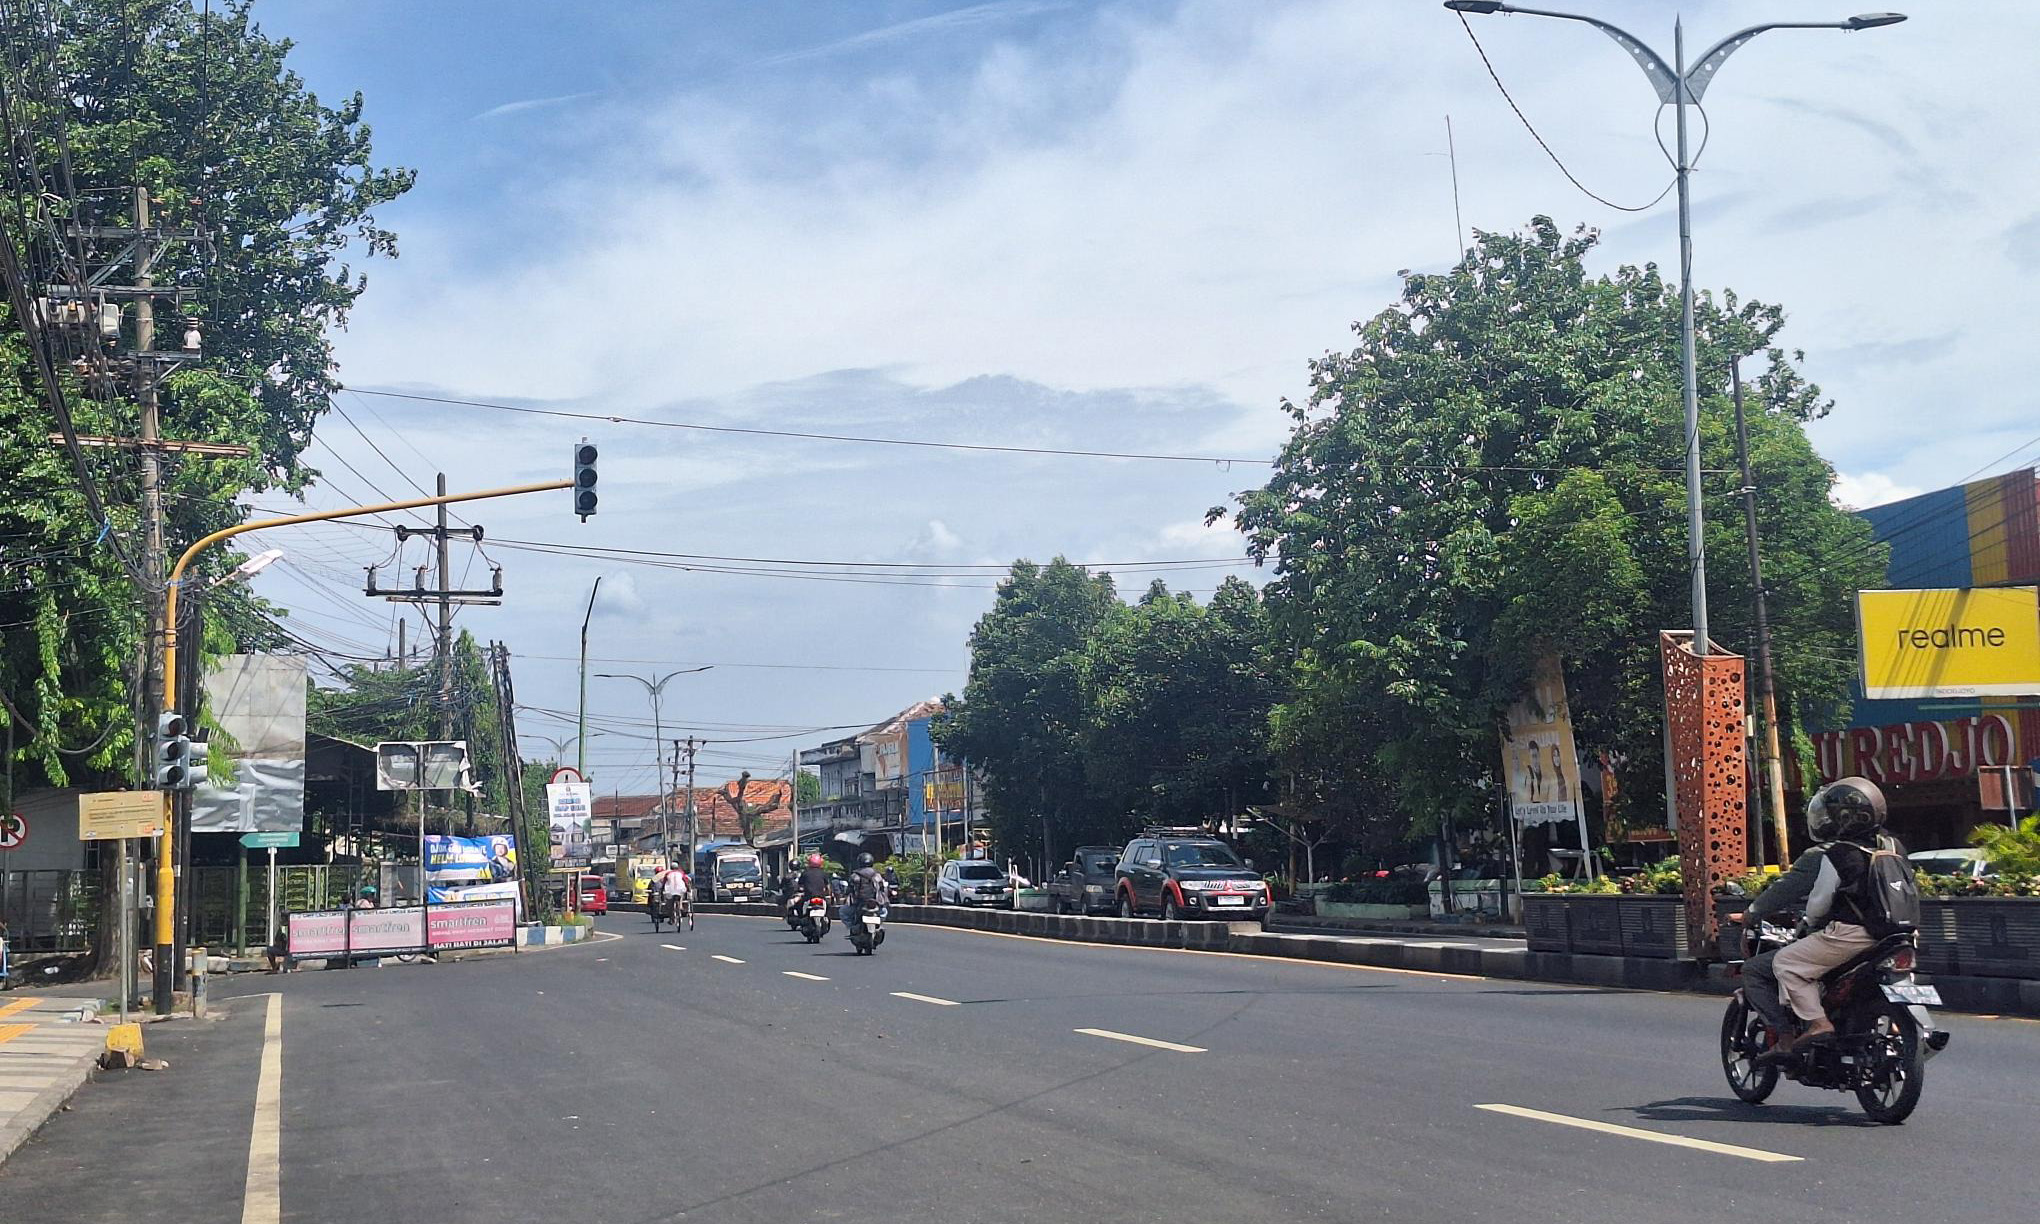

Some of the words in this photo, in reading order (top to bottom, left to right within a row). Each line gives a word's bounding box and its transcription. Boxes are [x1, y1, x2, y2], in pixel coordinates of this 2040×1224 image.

[1898, 624, 2005, 649] realme
[351, 920, 410, 934] smartfren
[430, 916, 488, 929] smartfren
